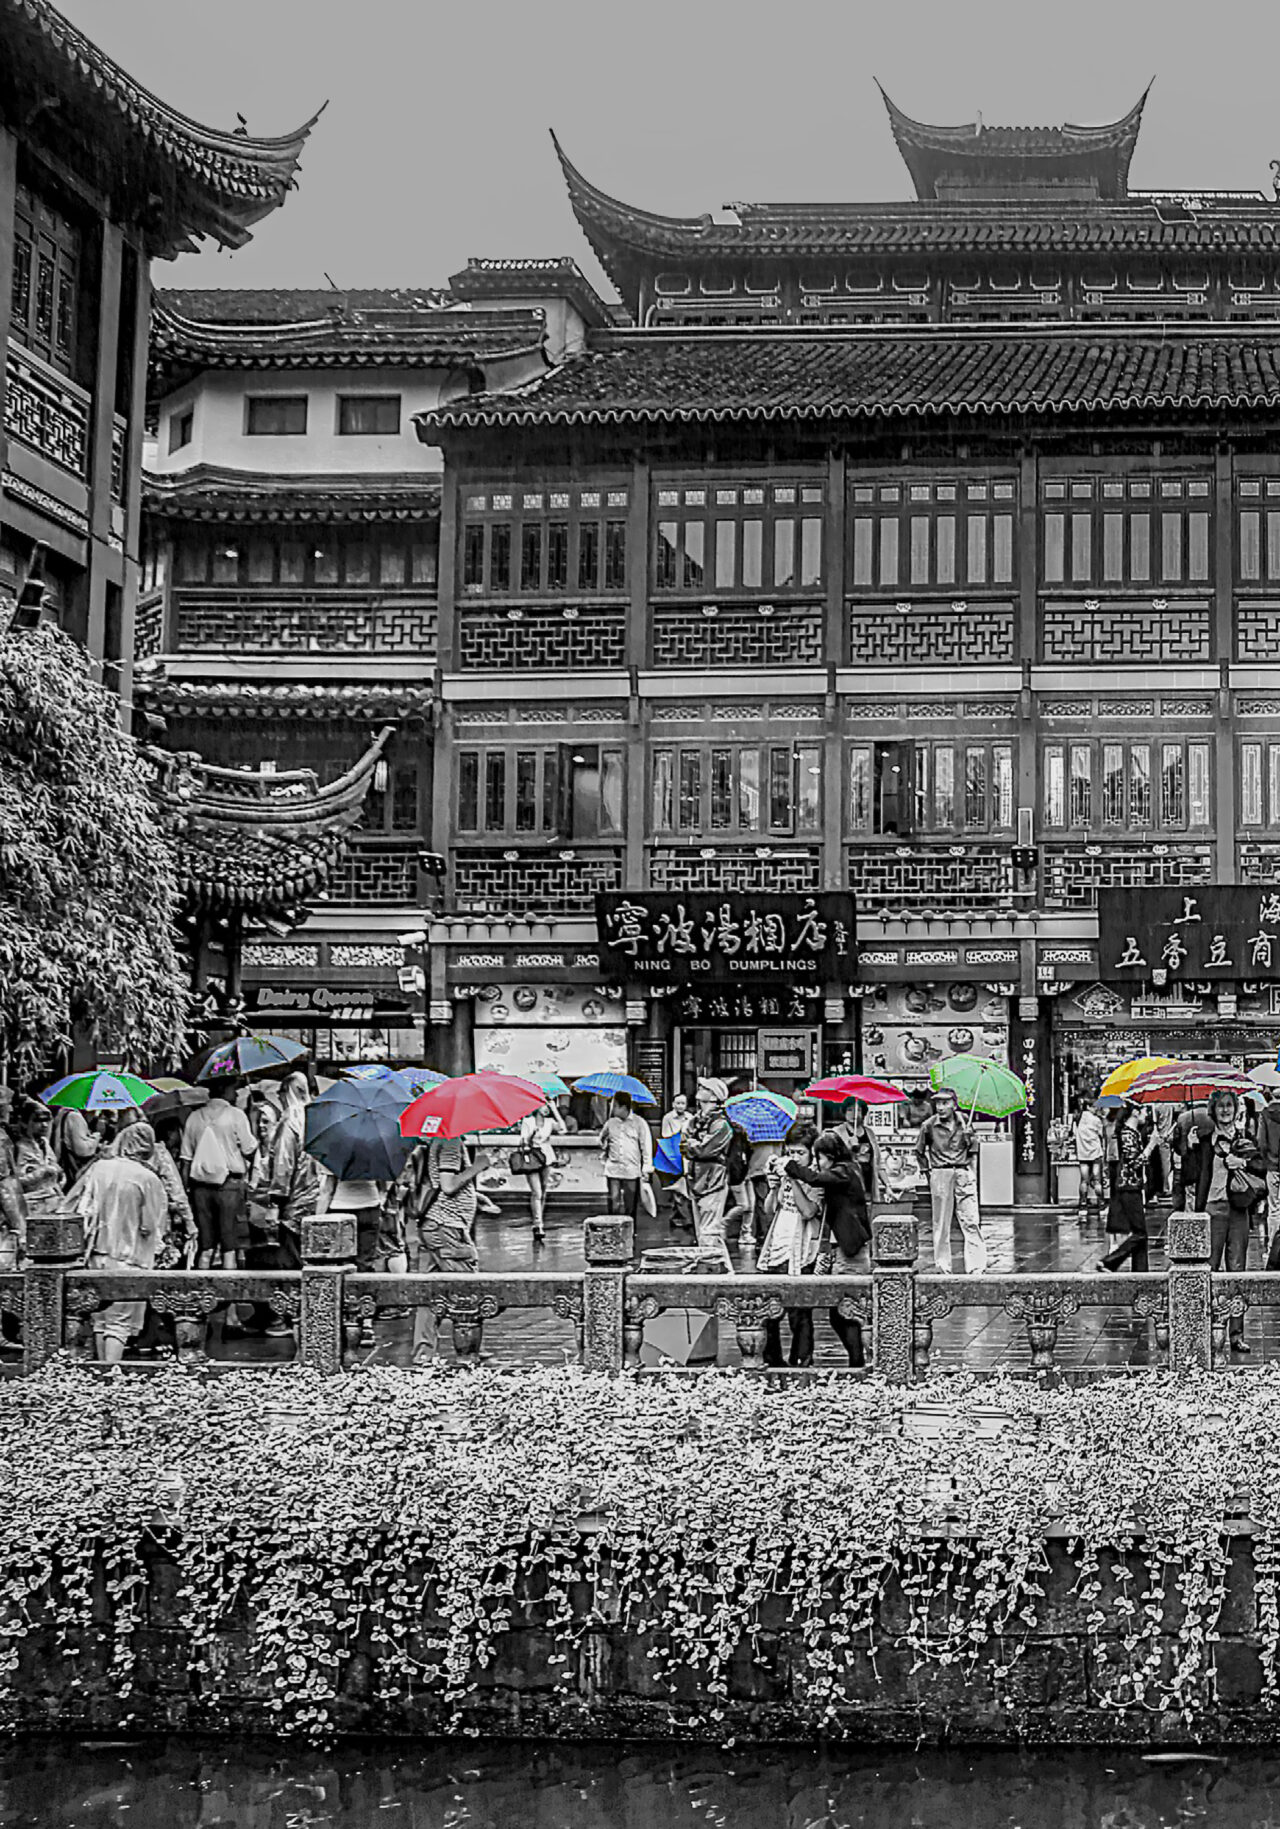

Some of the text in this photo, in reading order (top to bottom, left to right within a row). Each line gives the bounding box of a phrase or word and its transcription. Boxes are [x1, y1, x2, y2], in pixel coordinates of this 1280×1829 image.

[634, 959, 817, 971] NING BO DUMPLINGS
[257, 988, 374, 1008] Dairy Queen
